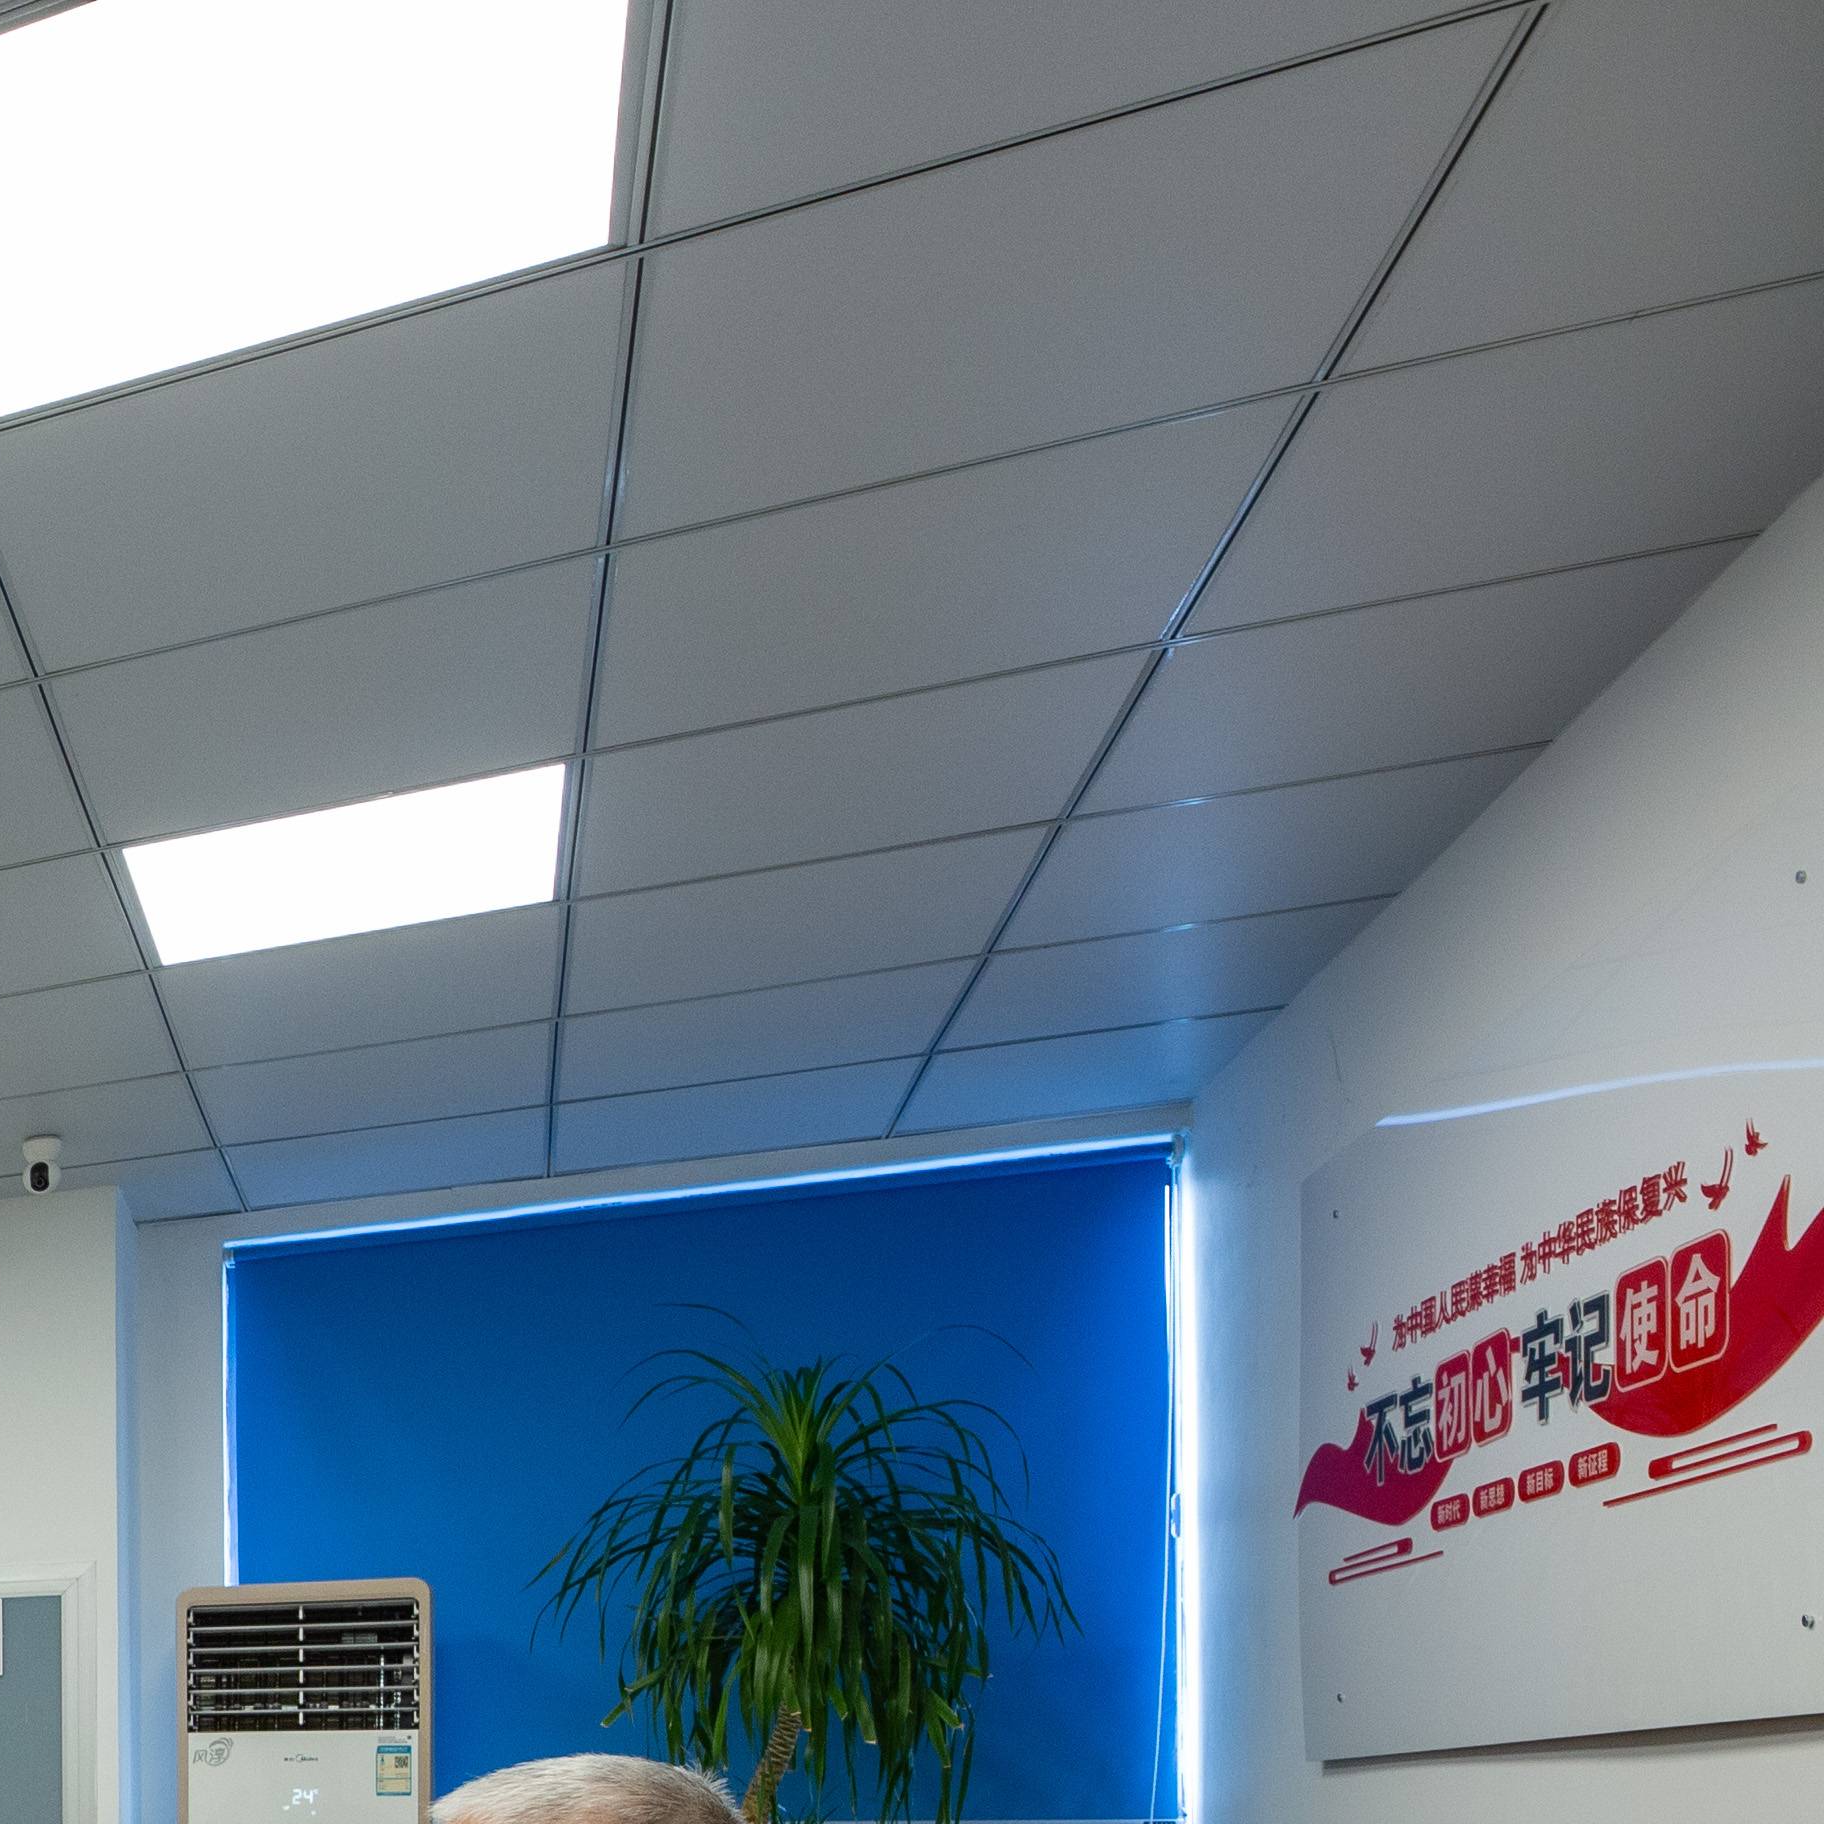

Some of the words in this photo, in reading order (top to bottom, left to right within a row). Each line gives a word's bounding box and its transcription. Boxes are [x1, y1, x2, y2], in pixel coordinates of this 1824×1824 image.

[1437, 1500, 1461, 1524] 新时代
[1480, 1484, 1504, 1511] 新思想
[1526, 1468, 1554, 1495] 新目标
[1578, 1450, 1608, 1479] 新征程
